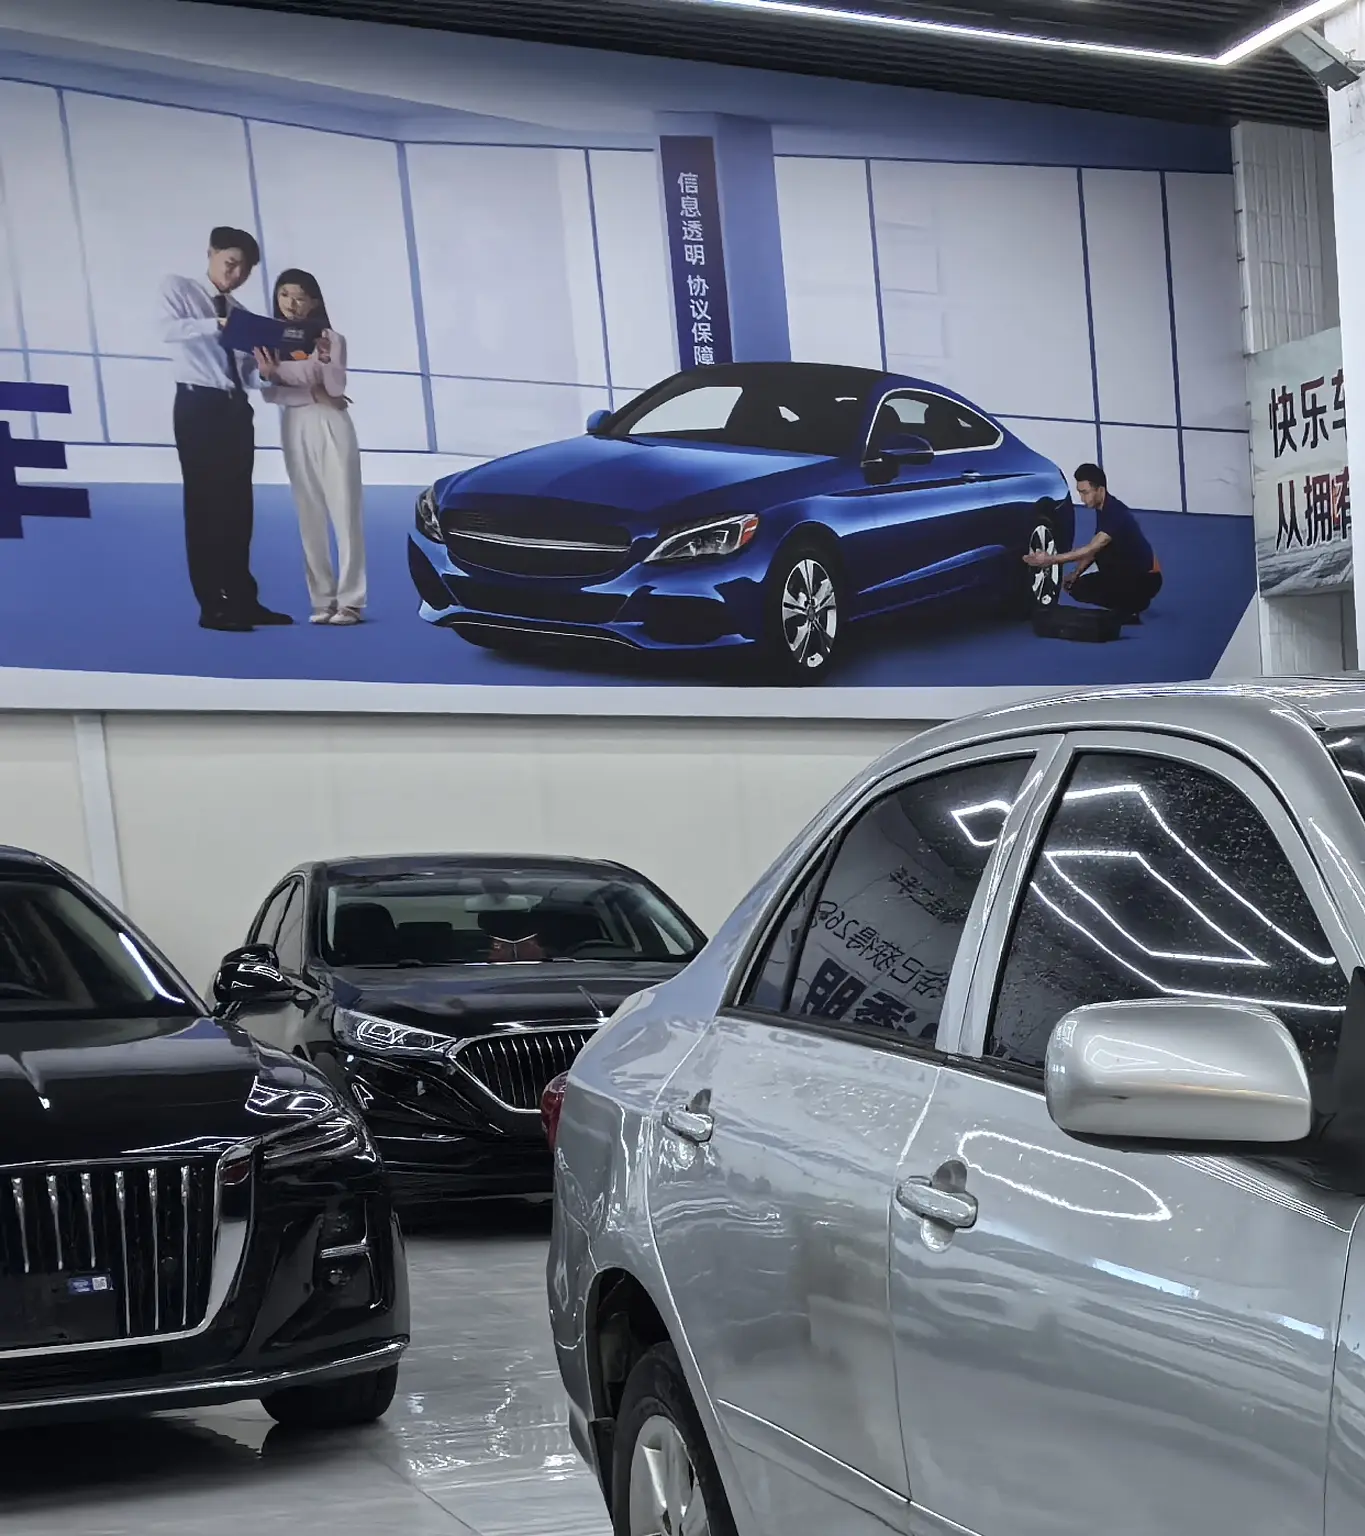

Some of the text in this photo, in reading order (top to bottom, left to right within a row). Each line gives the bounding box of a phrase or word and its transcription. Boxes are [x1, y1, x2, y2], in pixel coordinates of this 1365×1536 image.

[677, 171, 715, 365] 信息透明 协议保障
